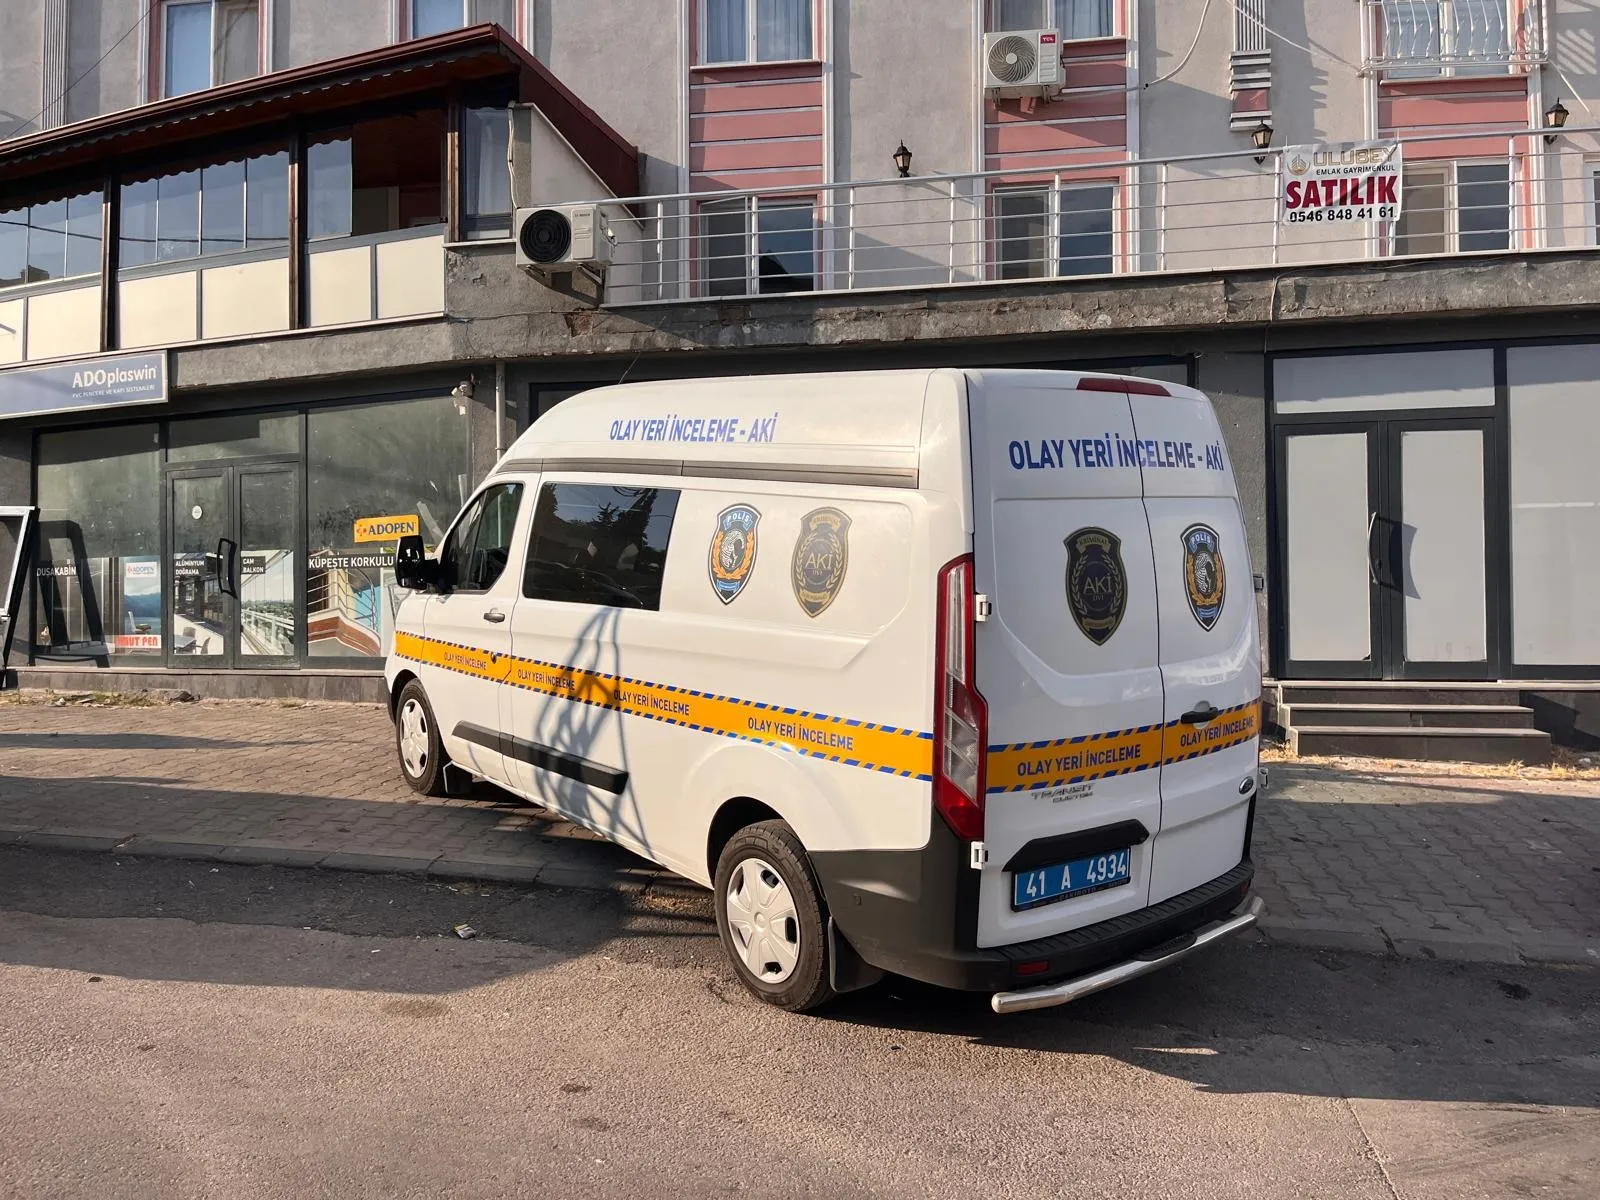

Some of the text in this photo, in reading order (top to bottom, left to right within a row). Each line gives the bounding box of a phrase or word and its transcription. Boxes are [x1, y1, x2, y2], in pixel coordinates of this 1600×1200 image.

[1313, 147, 1396, 166] ULUBEY
[1315, 167, 1341, 175] EMLAK
[1286, 176, 1398, 209] SATILIK
[1290, 206, 1394, 223] 0546 848 41 61
[72, 364, 157, 388] ADOplaswin
[609, 419, 641, 441] OLAY
[641, 414, 671, 441] YERİ
[668, 414, 739, 443] İNCELEME
[747, 412, 779, 443] AKİ
[1008, 439, 1064, 470] OLAY
[1068, 432, 1114, 468] YERİ
[1115, 432, 1196, 469] İNCELEME
[1206, 441, 1225, 471] AKİ
[368, 521, 415, 536] ADOPEN
[243, 566, 264, 574] BALKON
[805, 551, 833, 570] AKİ
[1083, 572, 1113, 595] AKİ
[443, 651, 455, 662] OLAY
[518, 668, 576, 691] OLAY YERİ İNCELEME
[613, 689, 690, 716] OLAY YERİ İNCELEME
[748, 717, 854, 751] OLAY YERİ İNCELEME
[1180, 729, 1202, 747] OLAY
[1204, 722, 1221, 741] YERİ
[1017, 744, 1141, 777] OLAY YERİ İNCELEME
[1026, 852, 1126, 897] 41 A 4934
